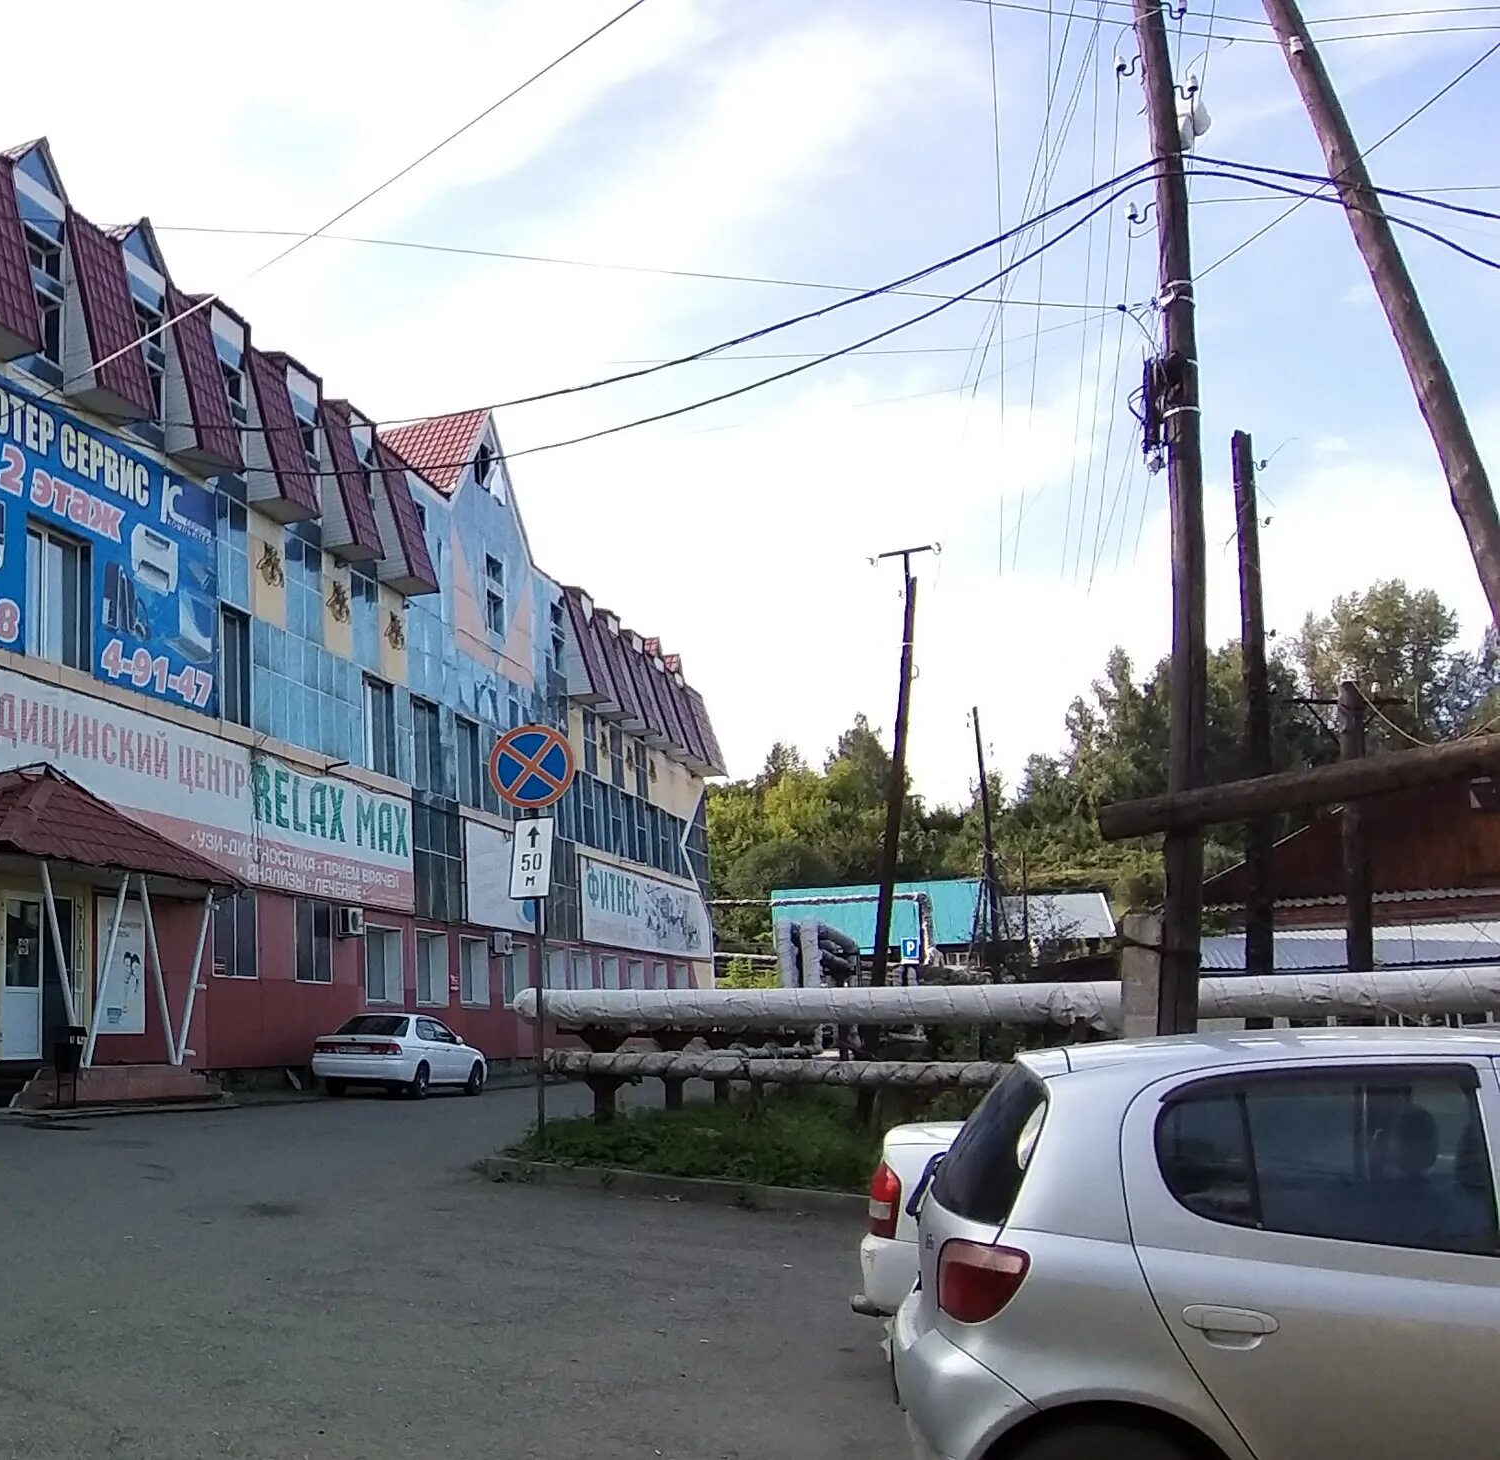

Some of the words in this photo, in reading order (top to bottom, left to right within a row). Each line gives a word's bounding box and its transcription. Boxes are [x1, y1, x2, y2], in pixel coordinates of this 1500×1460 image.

[60, 422, 150, 507] СЕРВИС
[29, 468, 127, 542] этаж
[101, 638, 213, 707] 4-91-47
[178, 744, 245, 799] ЦЕНТР
[252, 765, 347, 843] RELAX
[356, 794, 408, 858] MAX
[246, 865, 306, 892] АНАЛИЗЫ
[314, 877, 362, 901] ЛЕЧЕНИЕ
[521, 852, 542, 872] 50
[587, 866, 640, 918] ФИТНЕС
